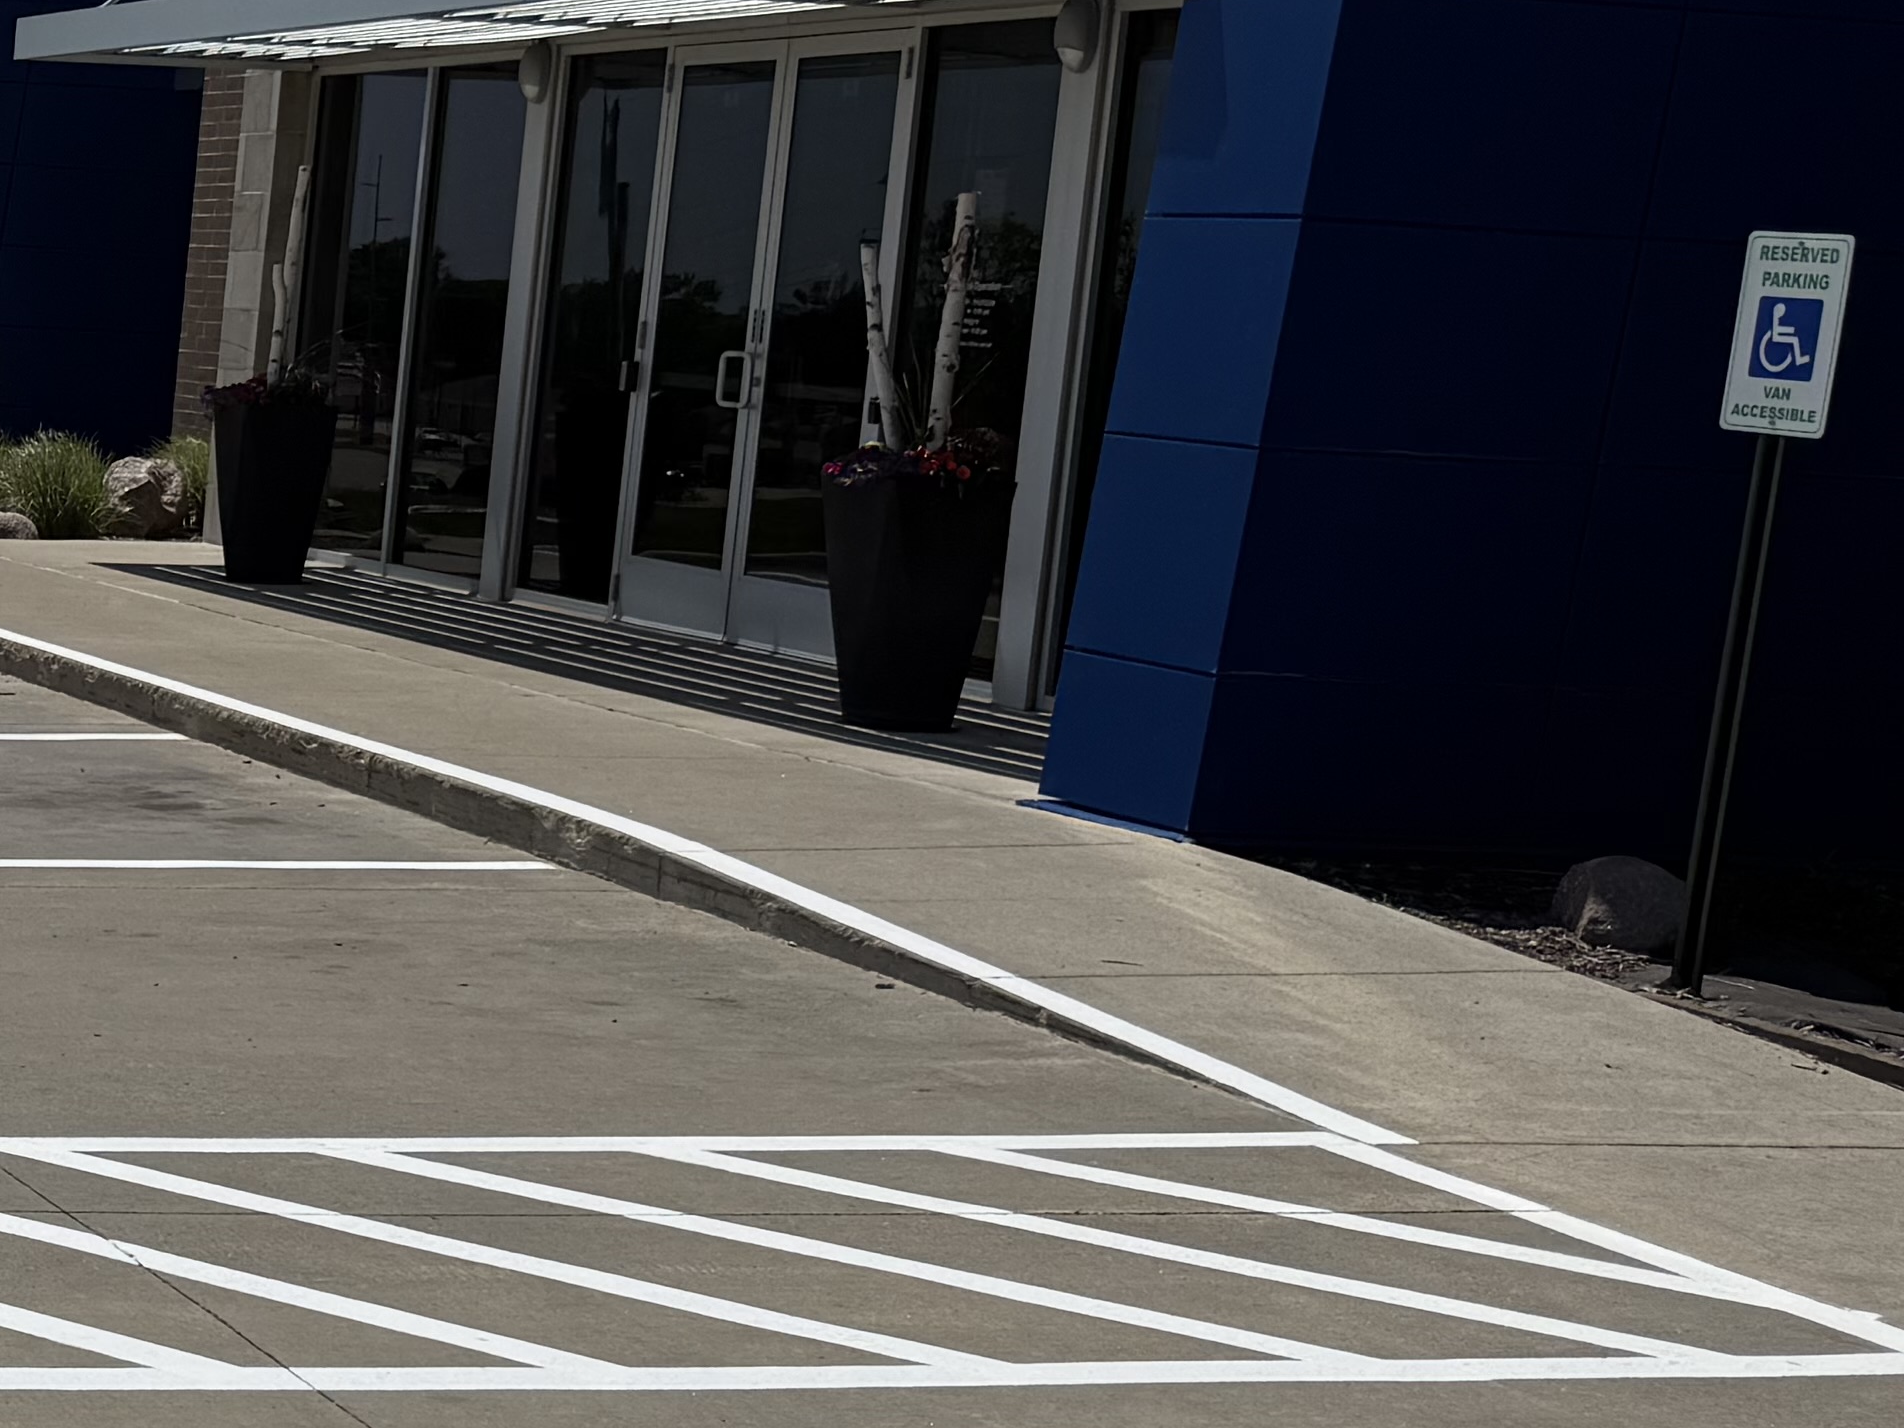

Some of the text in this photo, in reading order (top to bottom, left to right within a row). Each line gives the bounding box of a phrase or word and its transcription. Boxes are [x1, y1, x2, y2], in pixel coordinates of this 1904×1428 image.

[1759, 244, 1840, 264] RESERVED
[1761, 271, 1830, 290] PARKING
[1764, 385, 1791, 401] VAN
[1730, 403, 1817, 423] ACCESSIBLE
